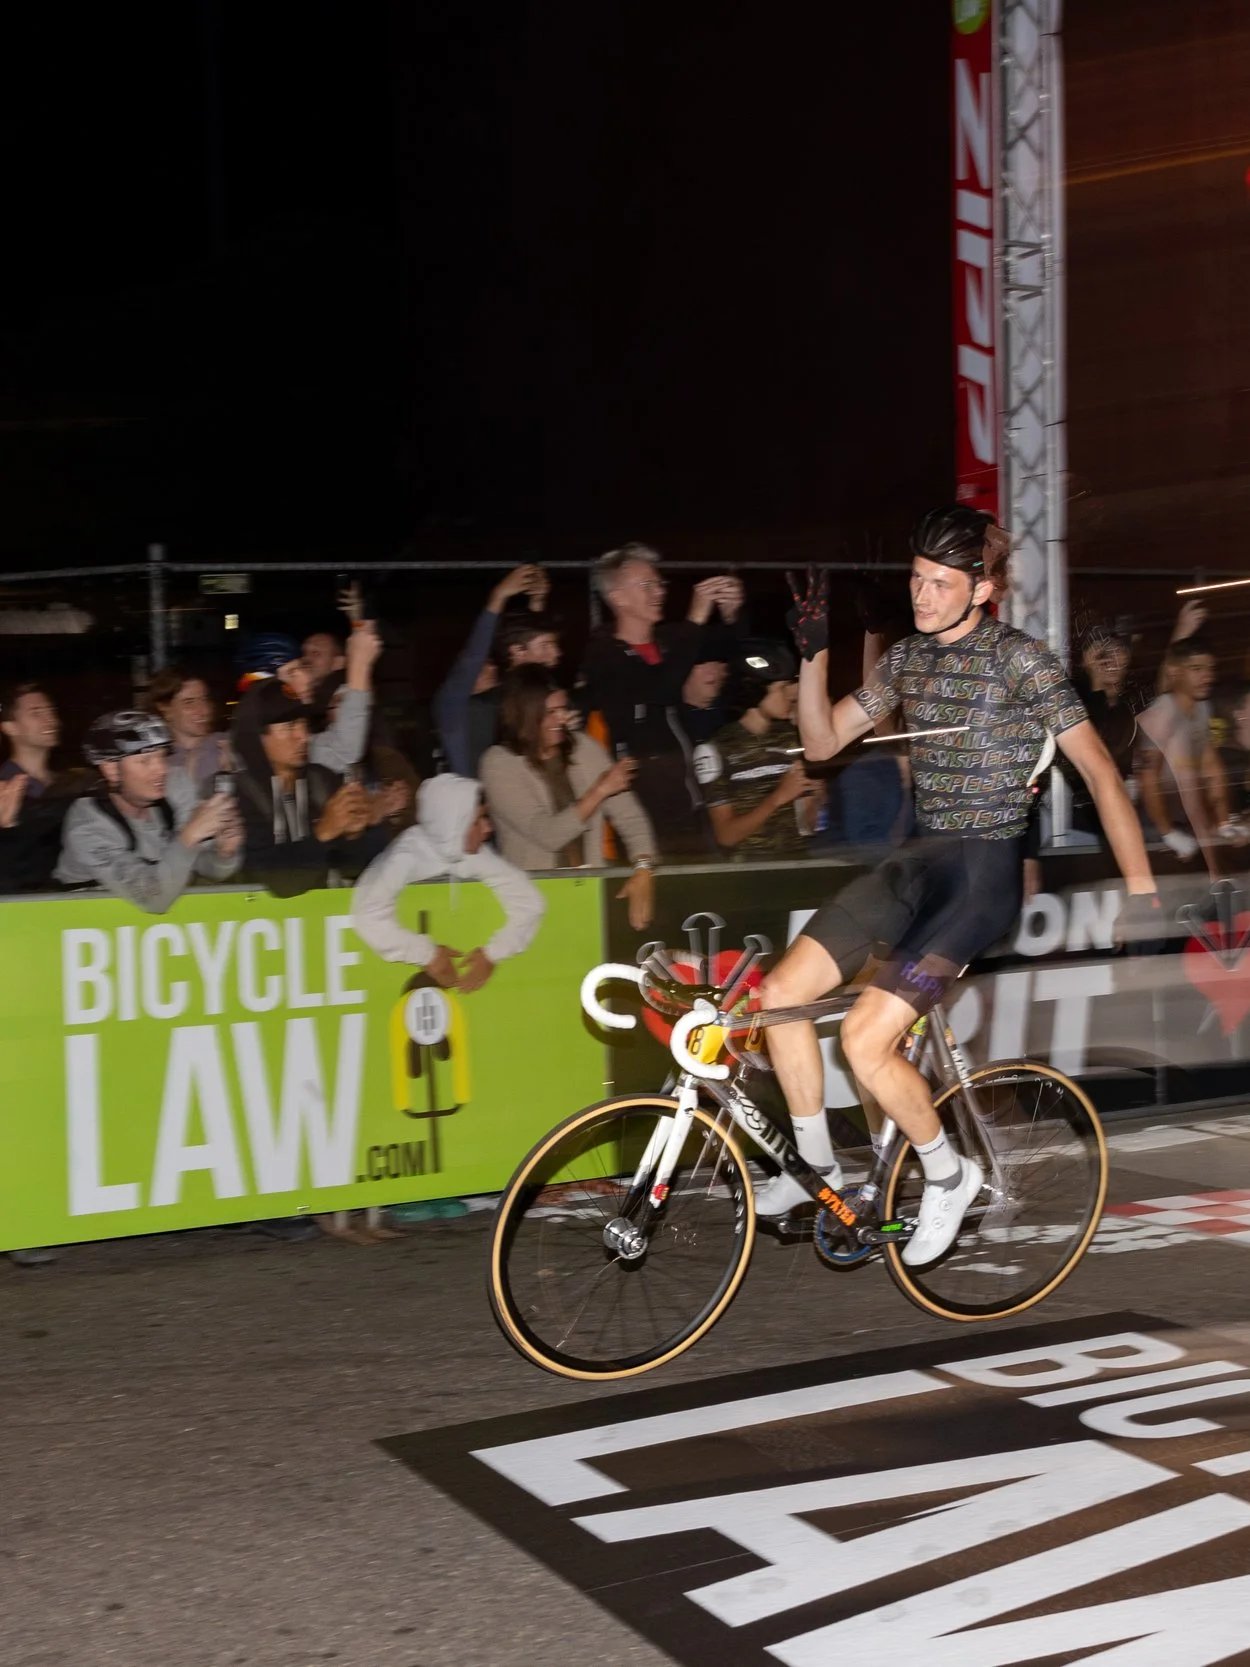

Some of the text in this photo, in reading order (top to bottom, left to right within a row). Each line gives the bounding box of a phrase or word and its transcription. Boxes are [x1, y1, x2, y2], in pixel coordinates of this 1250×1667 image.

[62, 916, 366, 1025] BICYCLE
[64, 1013, 366, 1217] LAW
[356, 1140, 426, 1183] .COM
